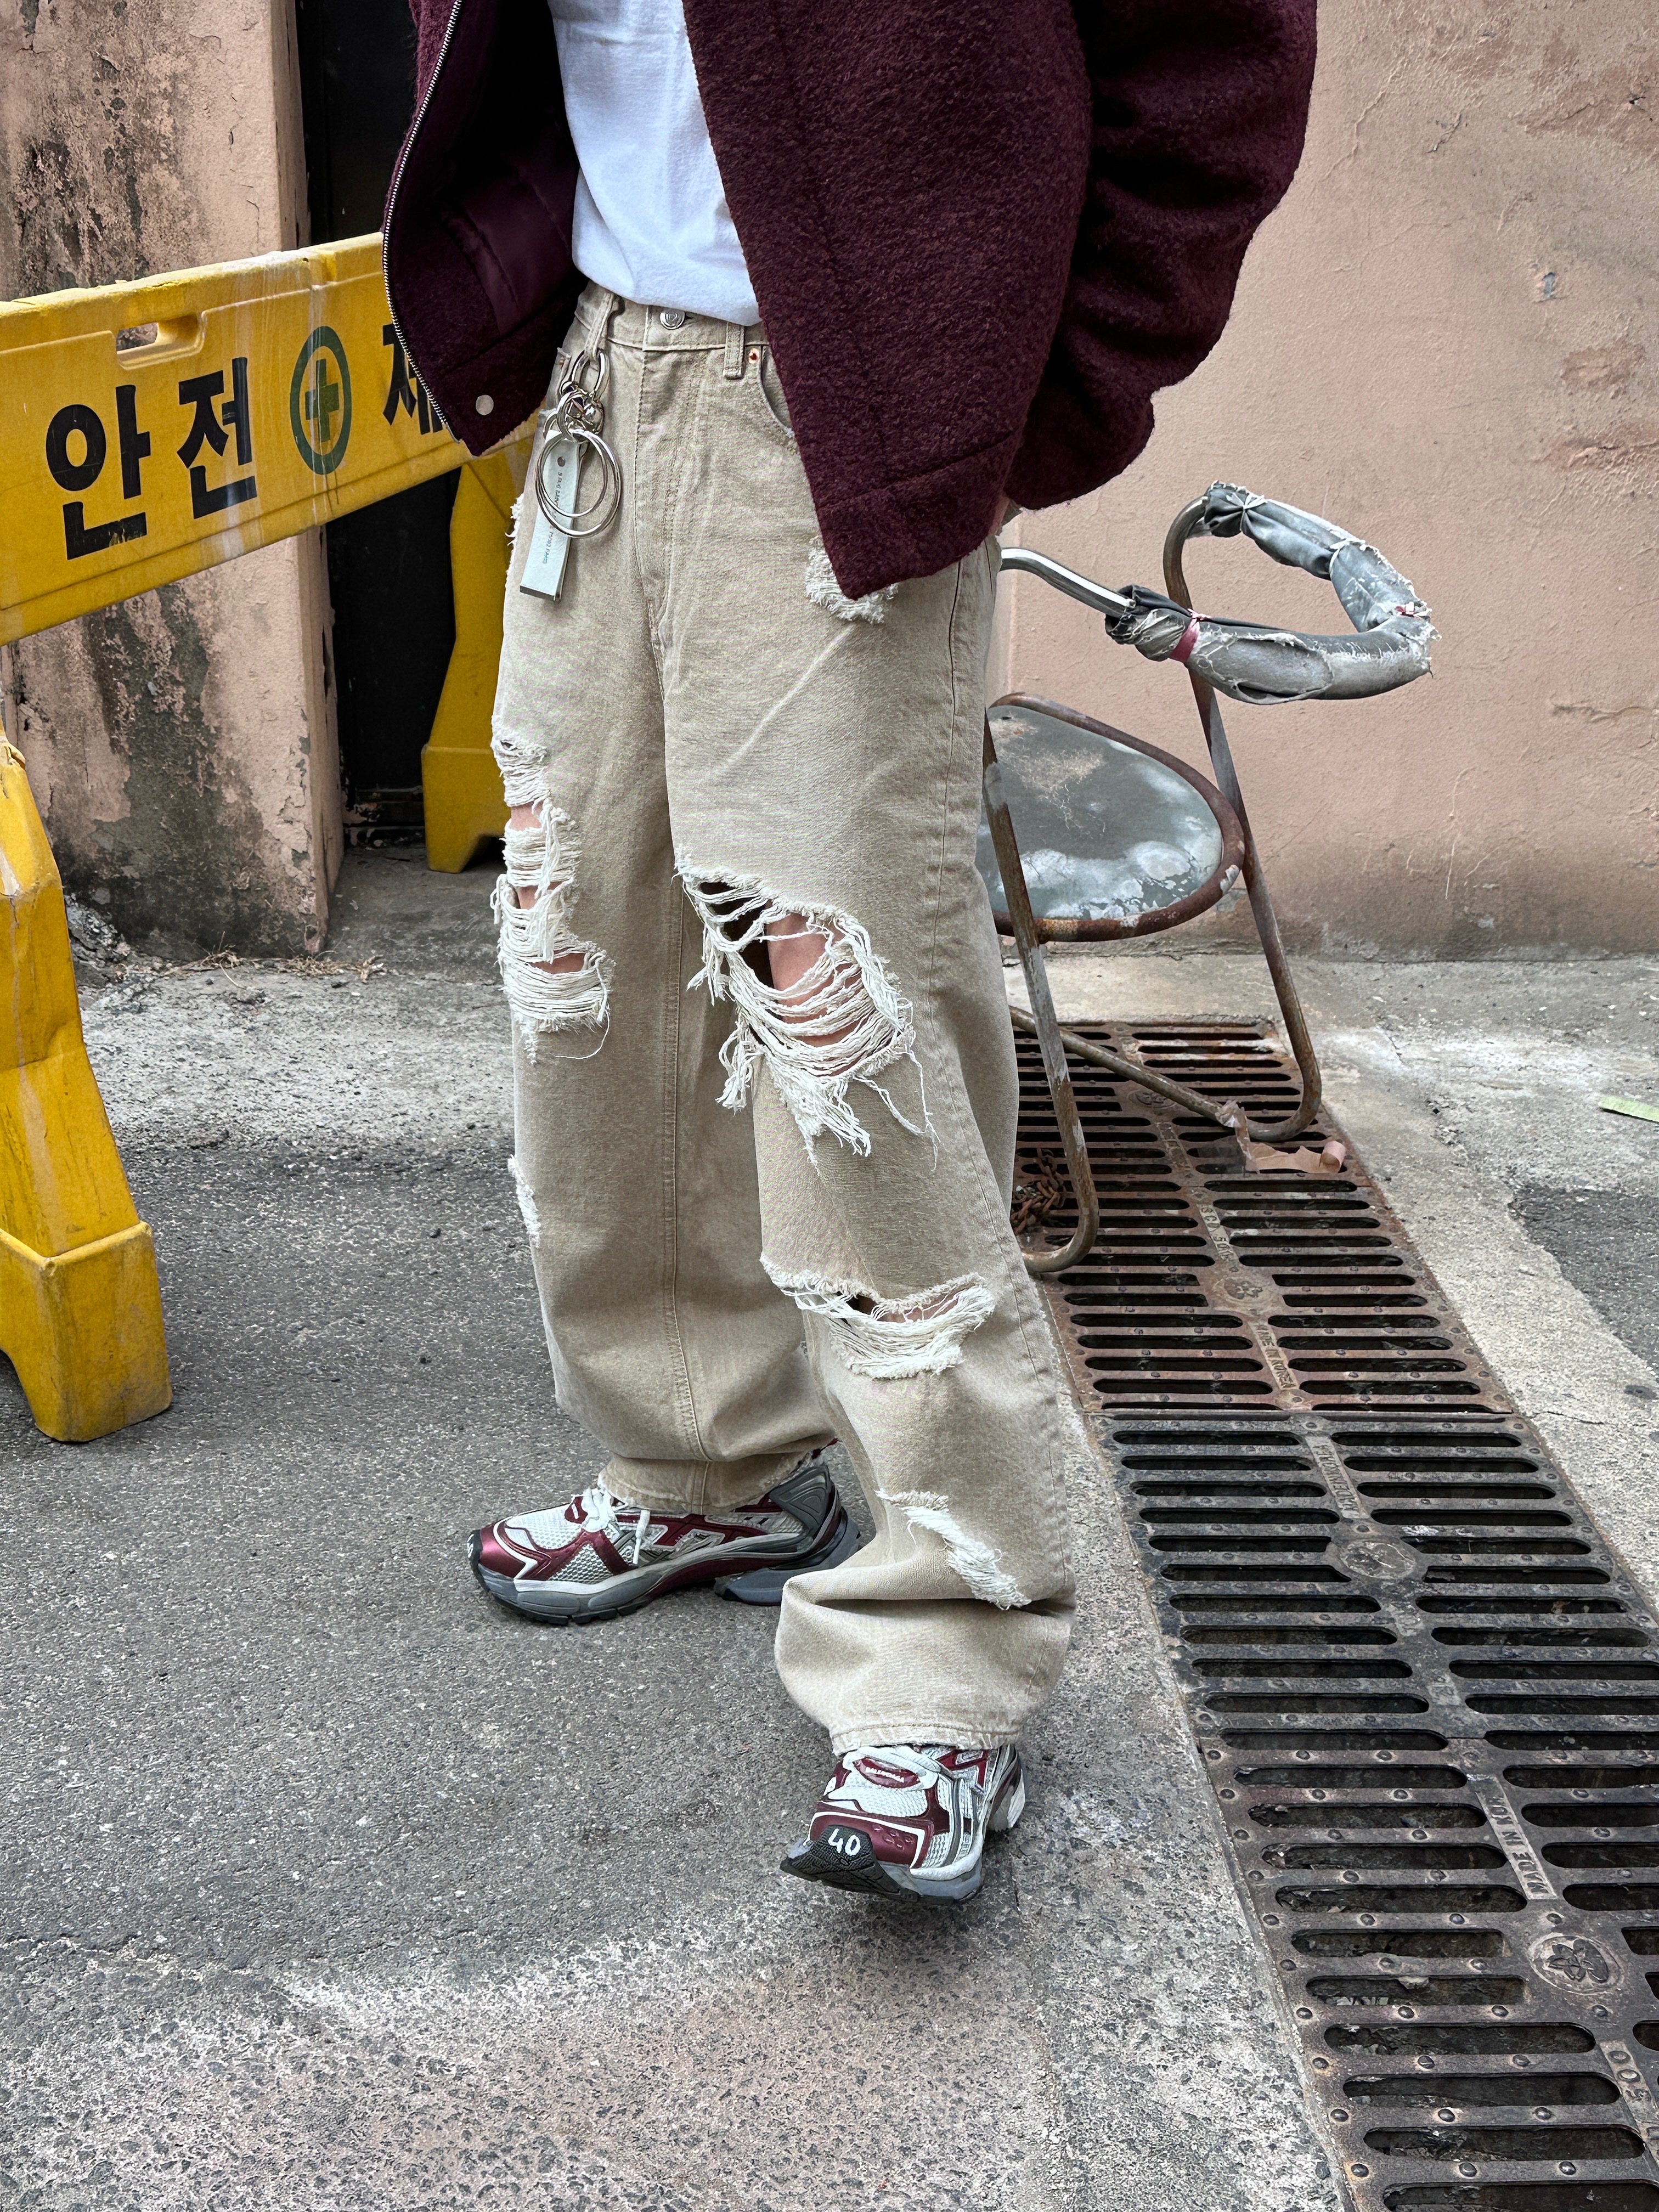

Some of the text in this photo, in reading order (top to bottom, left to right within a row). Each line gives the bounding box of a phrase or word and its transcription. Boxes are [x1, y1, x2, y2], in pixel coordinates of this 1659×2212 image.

[46, 357, 257, 560] 안전
[828, 1828, 861, 1857] 40
[1502, 1831, 1526, 1846] IN
[1512, 1852, 1549, 1893] MADE
